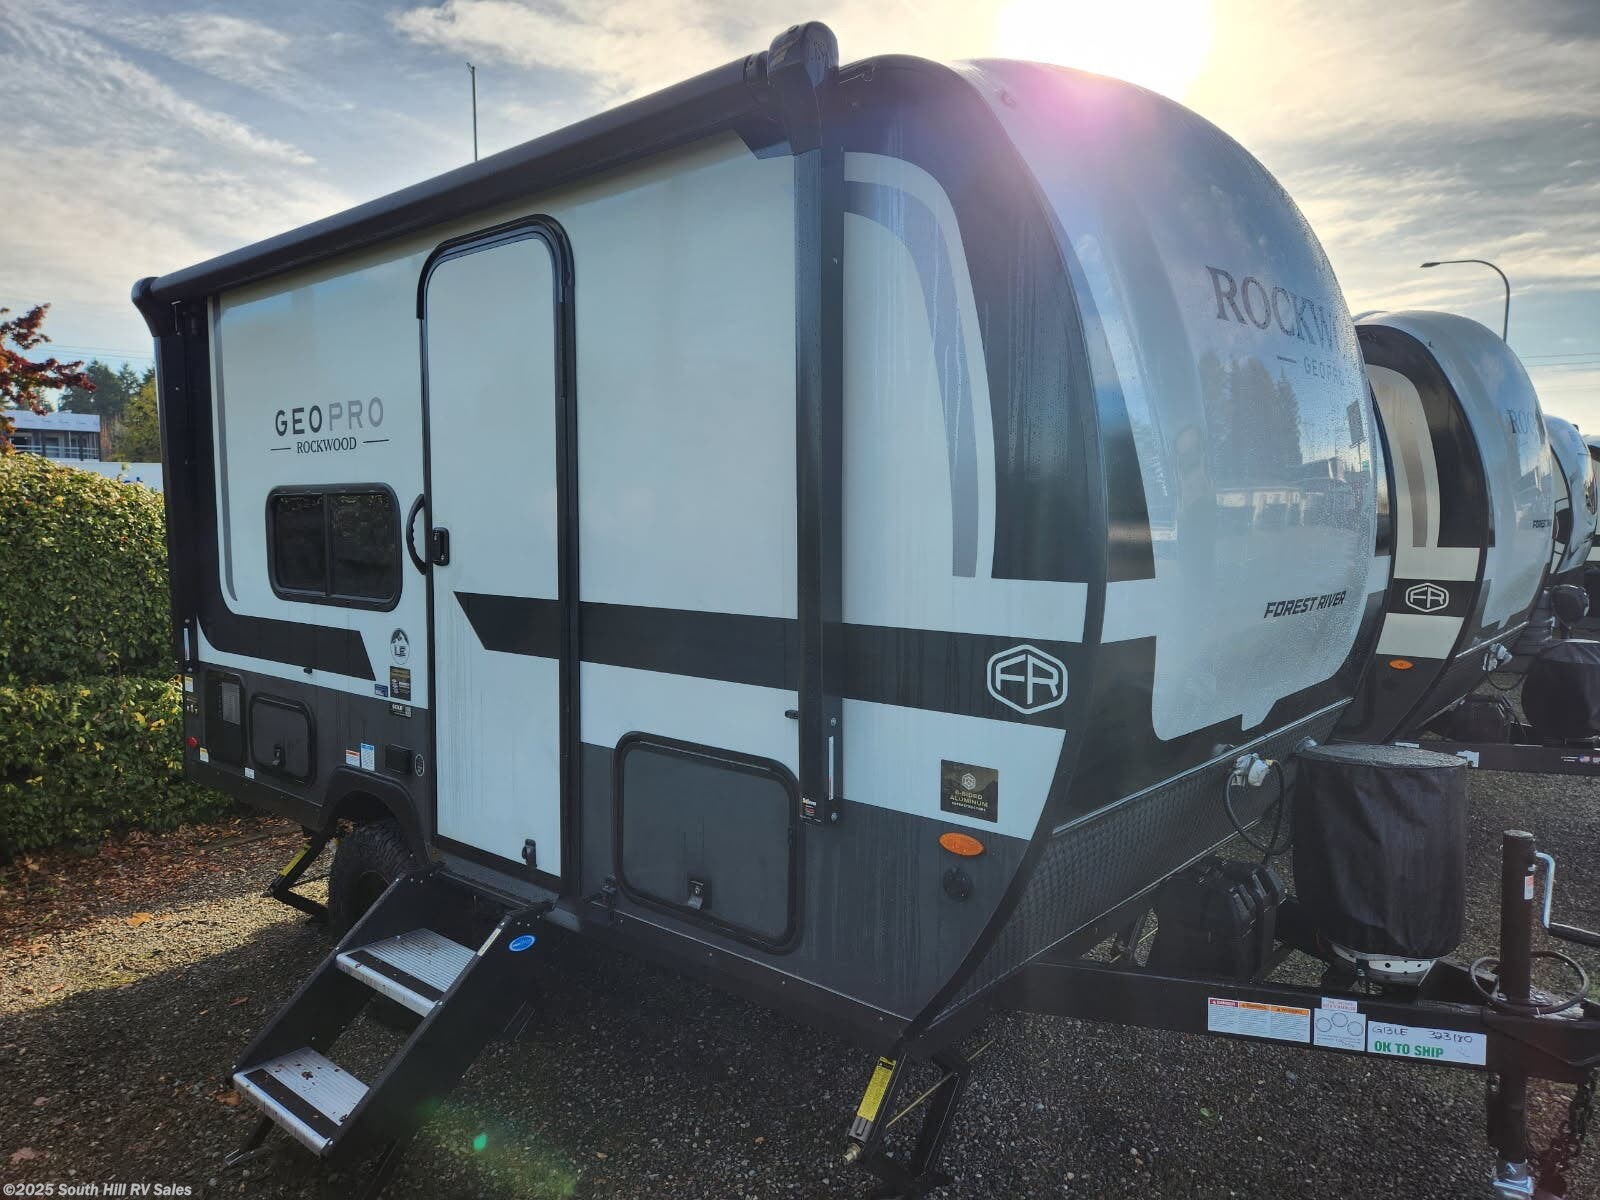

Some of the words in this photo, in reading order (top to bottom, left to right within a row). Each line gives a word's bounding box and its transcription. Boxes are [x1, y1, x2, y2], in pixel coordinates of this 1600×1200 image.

[296, 436, 358, 454] ROCKWOOD
[1263, 596, 1319, 619] FOREST
[1317, 589, 1347, 610] RIVER
[949, 794, 989, 808] ALUMINUM
[1374, 1040, 1391, 1052] OK
[1394, 1043, 1410, 1055] TO
[1414, 1045, 1444, 1058] SHIP
